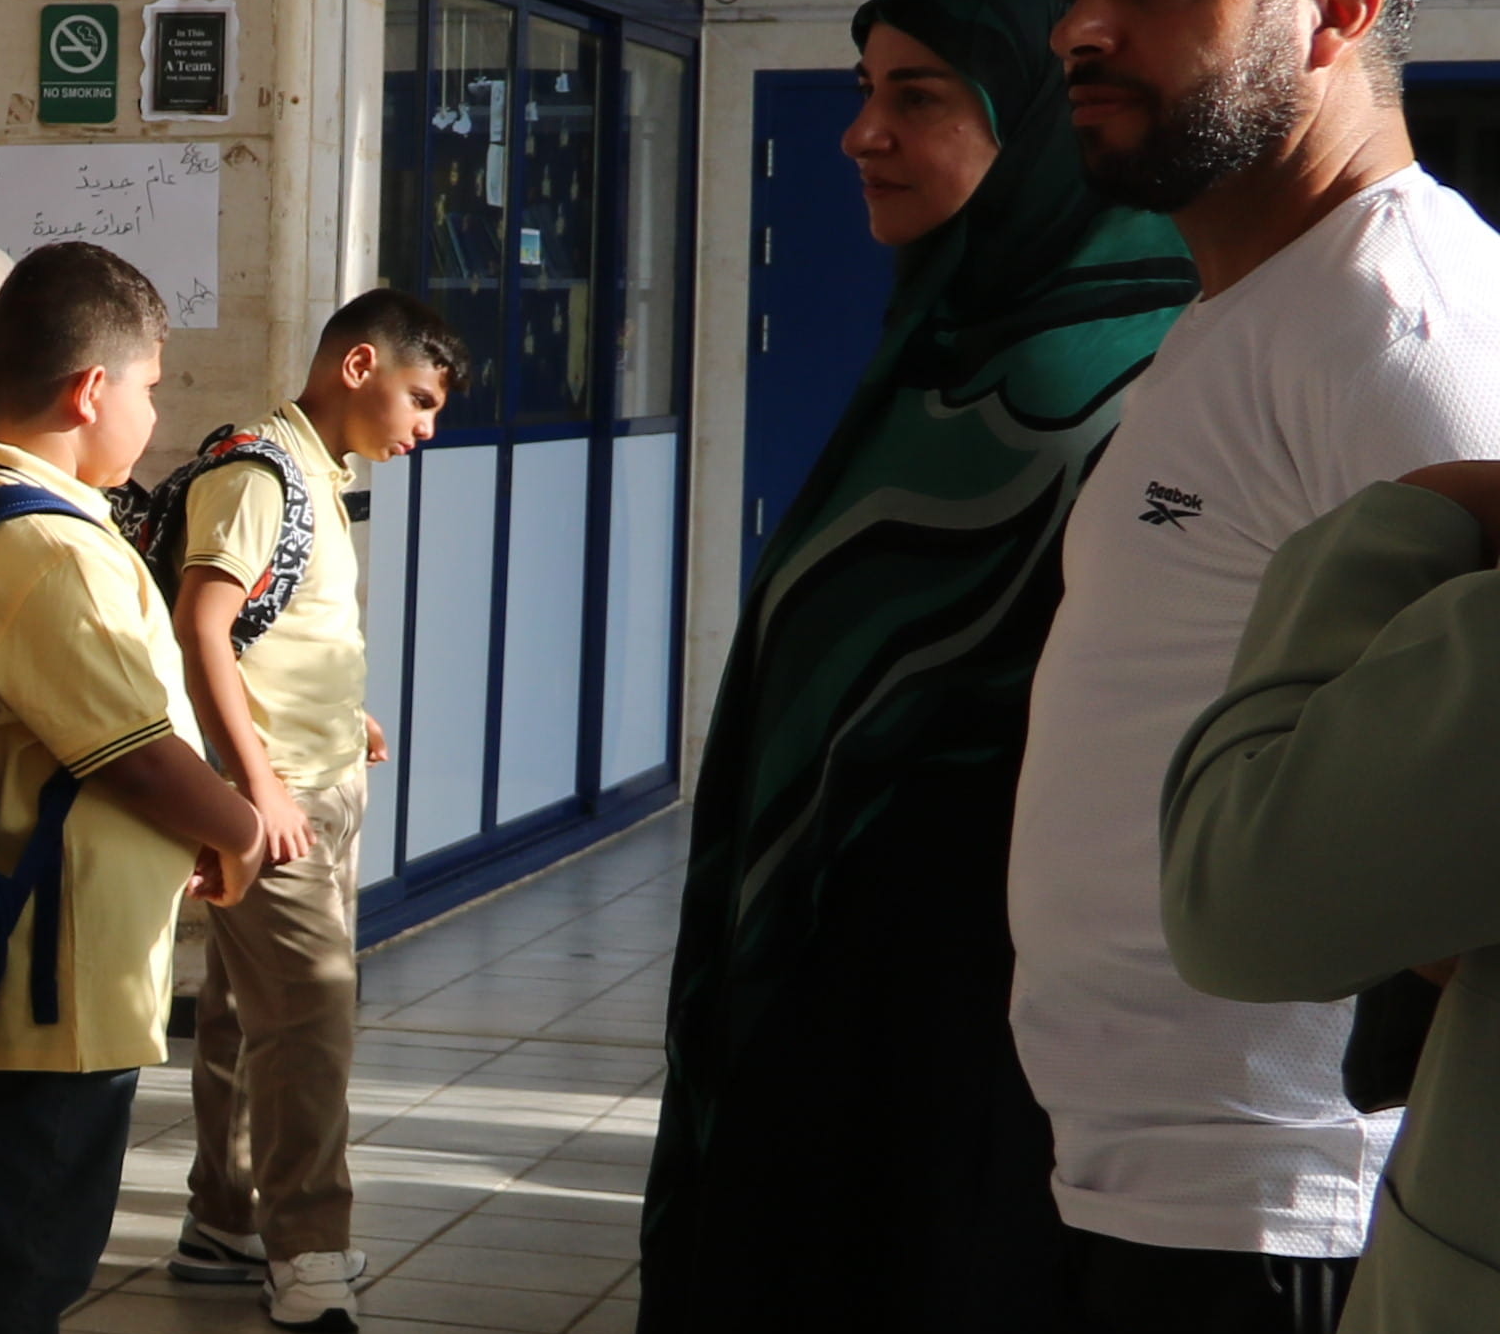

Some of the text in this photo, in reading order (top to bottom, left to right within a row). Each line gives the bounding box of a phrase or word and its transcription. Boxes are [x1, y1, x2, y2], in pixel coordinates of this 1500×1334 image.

[164, 60, 217, 72] A Team.
[43, 87, 112, 98] NO SMOKING
[1145, 481, 1203, 511] Reebok
